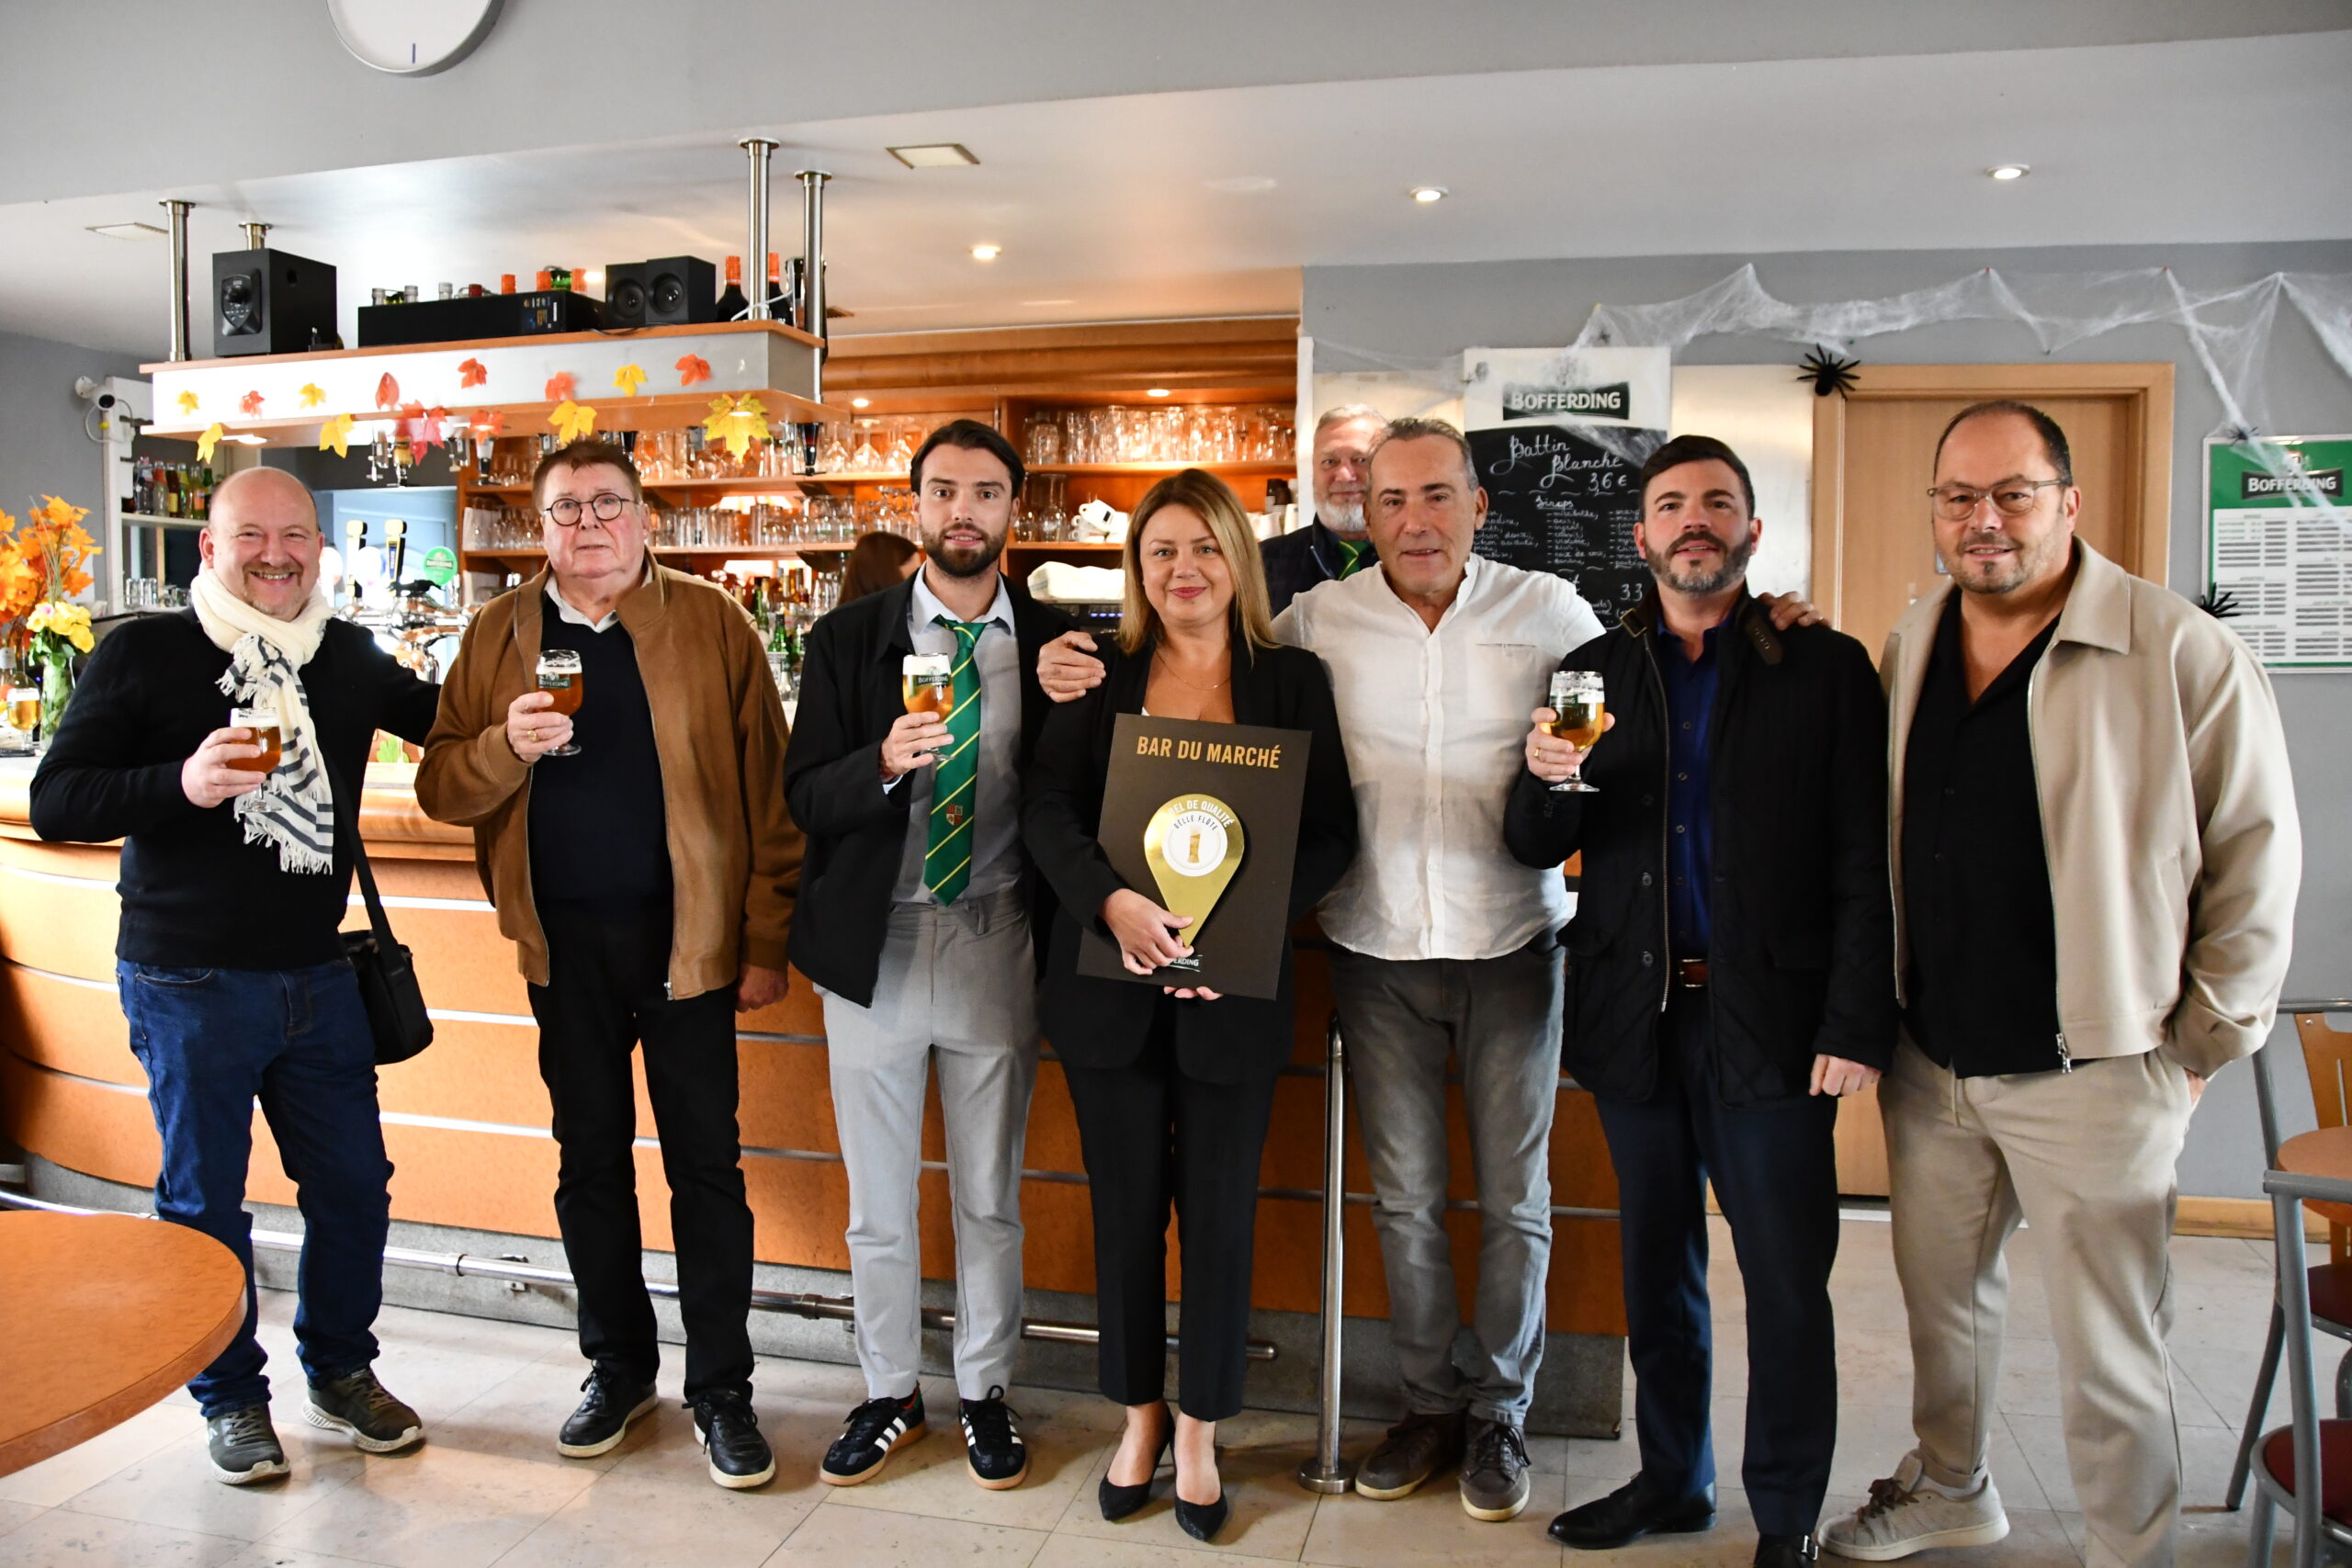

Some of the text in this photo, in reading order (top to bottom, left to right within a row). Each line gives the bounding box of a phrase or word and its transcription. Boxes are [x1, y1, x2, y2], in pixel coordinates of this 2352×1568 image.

[1511, 391, 1621, 410] BOFFERDING
[1490, 434, 1570, 475] Battin
[1540, 451, 1623, 488] Blanche
[2247, 476, 2336, 492] BOFFERNG
[1136, 736, 1282, 769] BAR DU MARCHÉ
[1186, 800, 1199, 809] DE
[1201, 801, 1236, 828] QUALITÉ
[1172, 957, 1199, 966] ERDING
